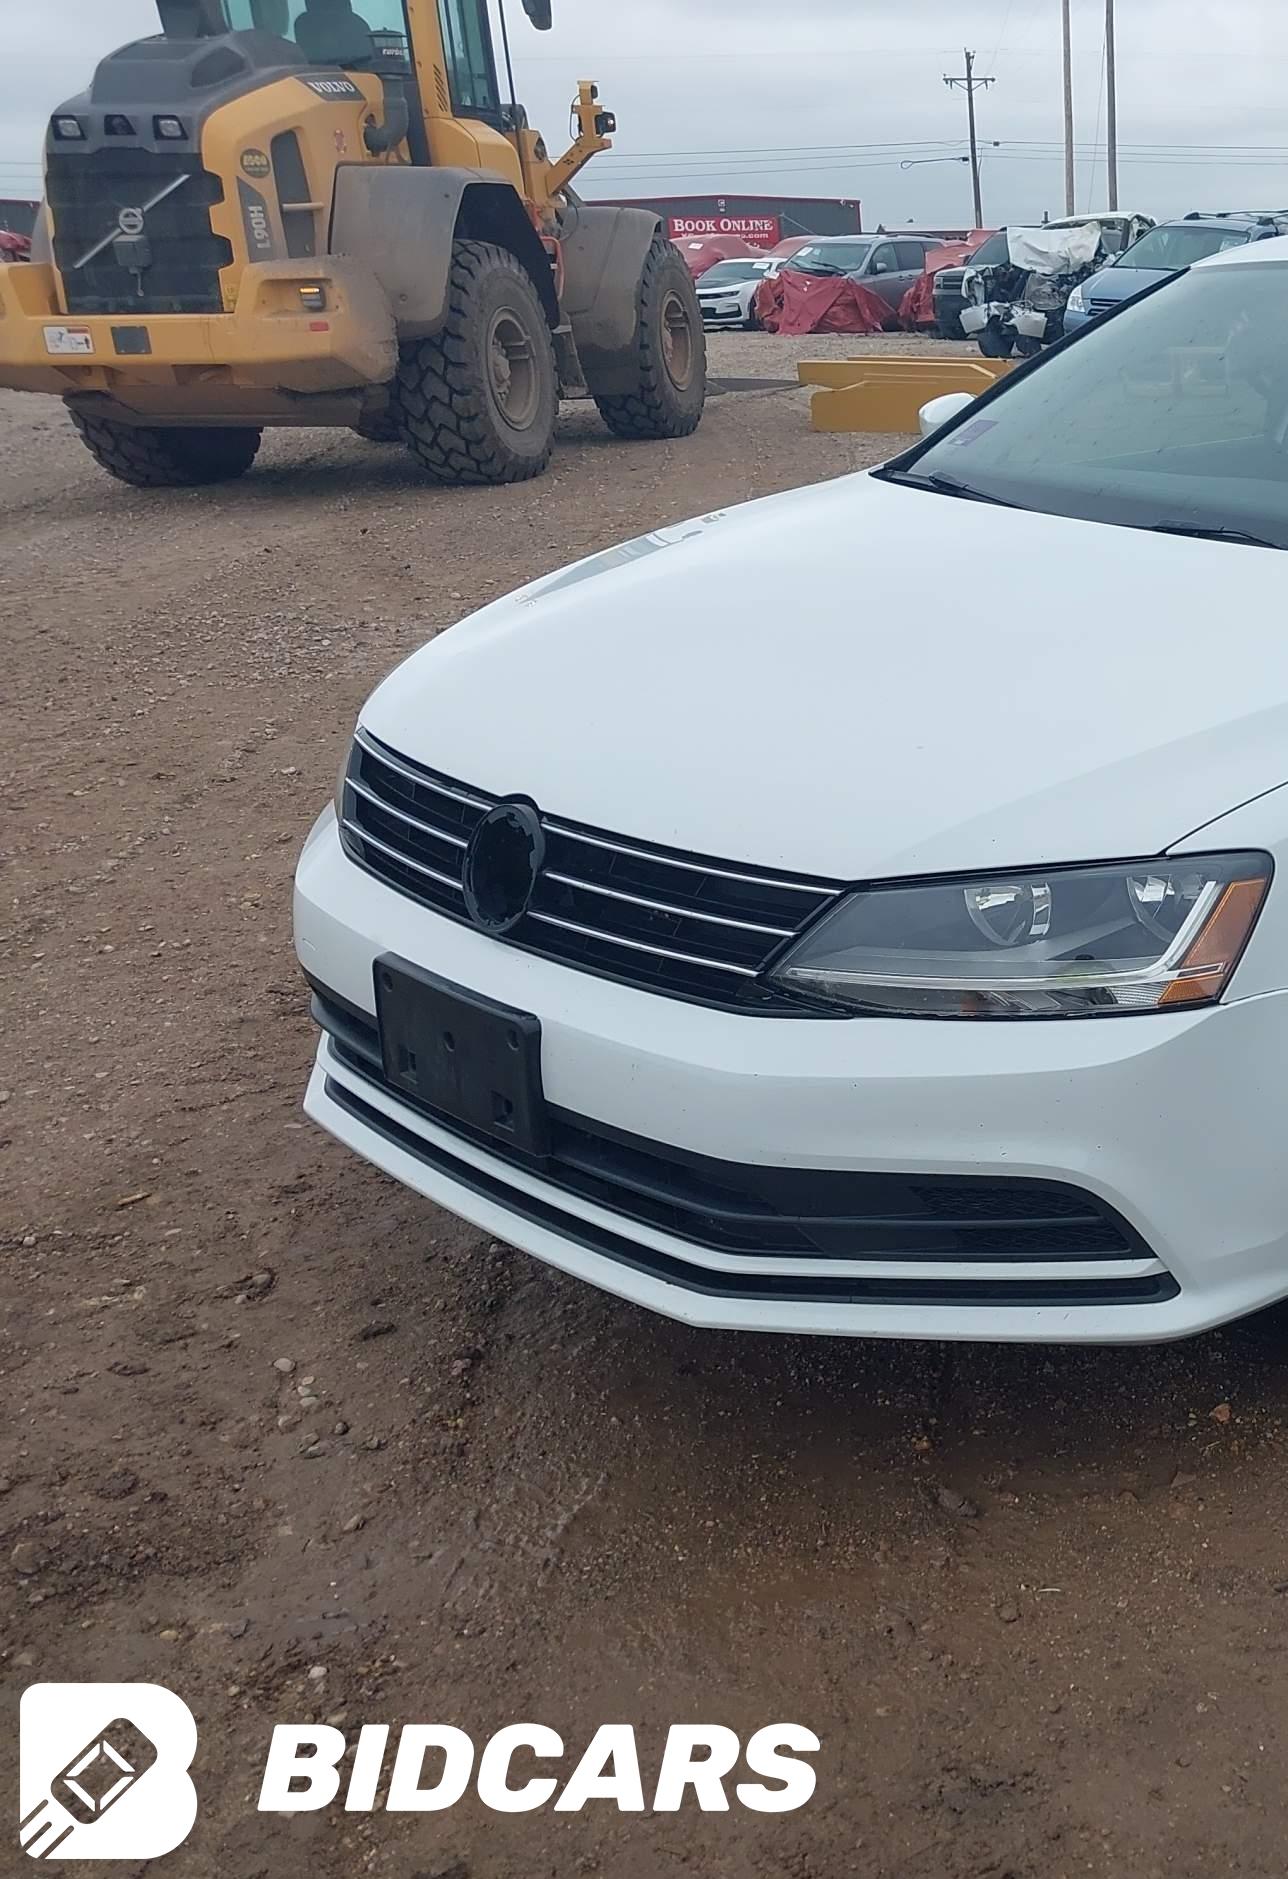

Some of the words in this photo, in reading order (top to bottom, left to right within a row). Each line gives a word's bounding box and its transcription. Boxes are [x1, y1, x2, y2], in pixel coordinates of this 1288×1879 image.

[307, 81, 356, 93] VOLVO
[247, 205, 273, 249] L90H
[674, 219, 717, 231] BOOK
[720, 219, 773, 231] ONLINE
